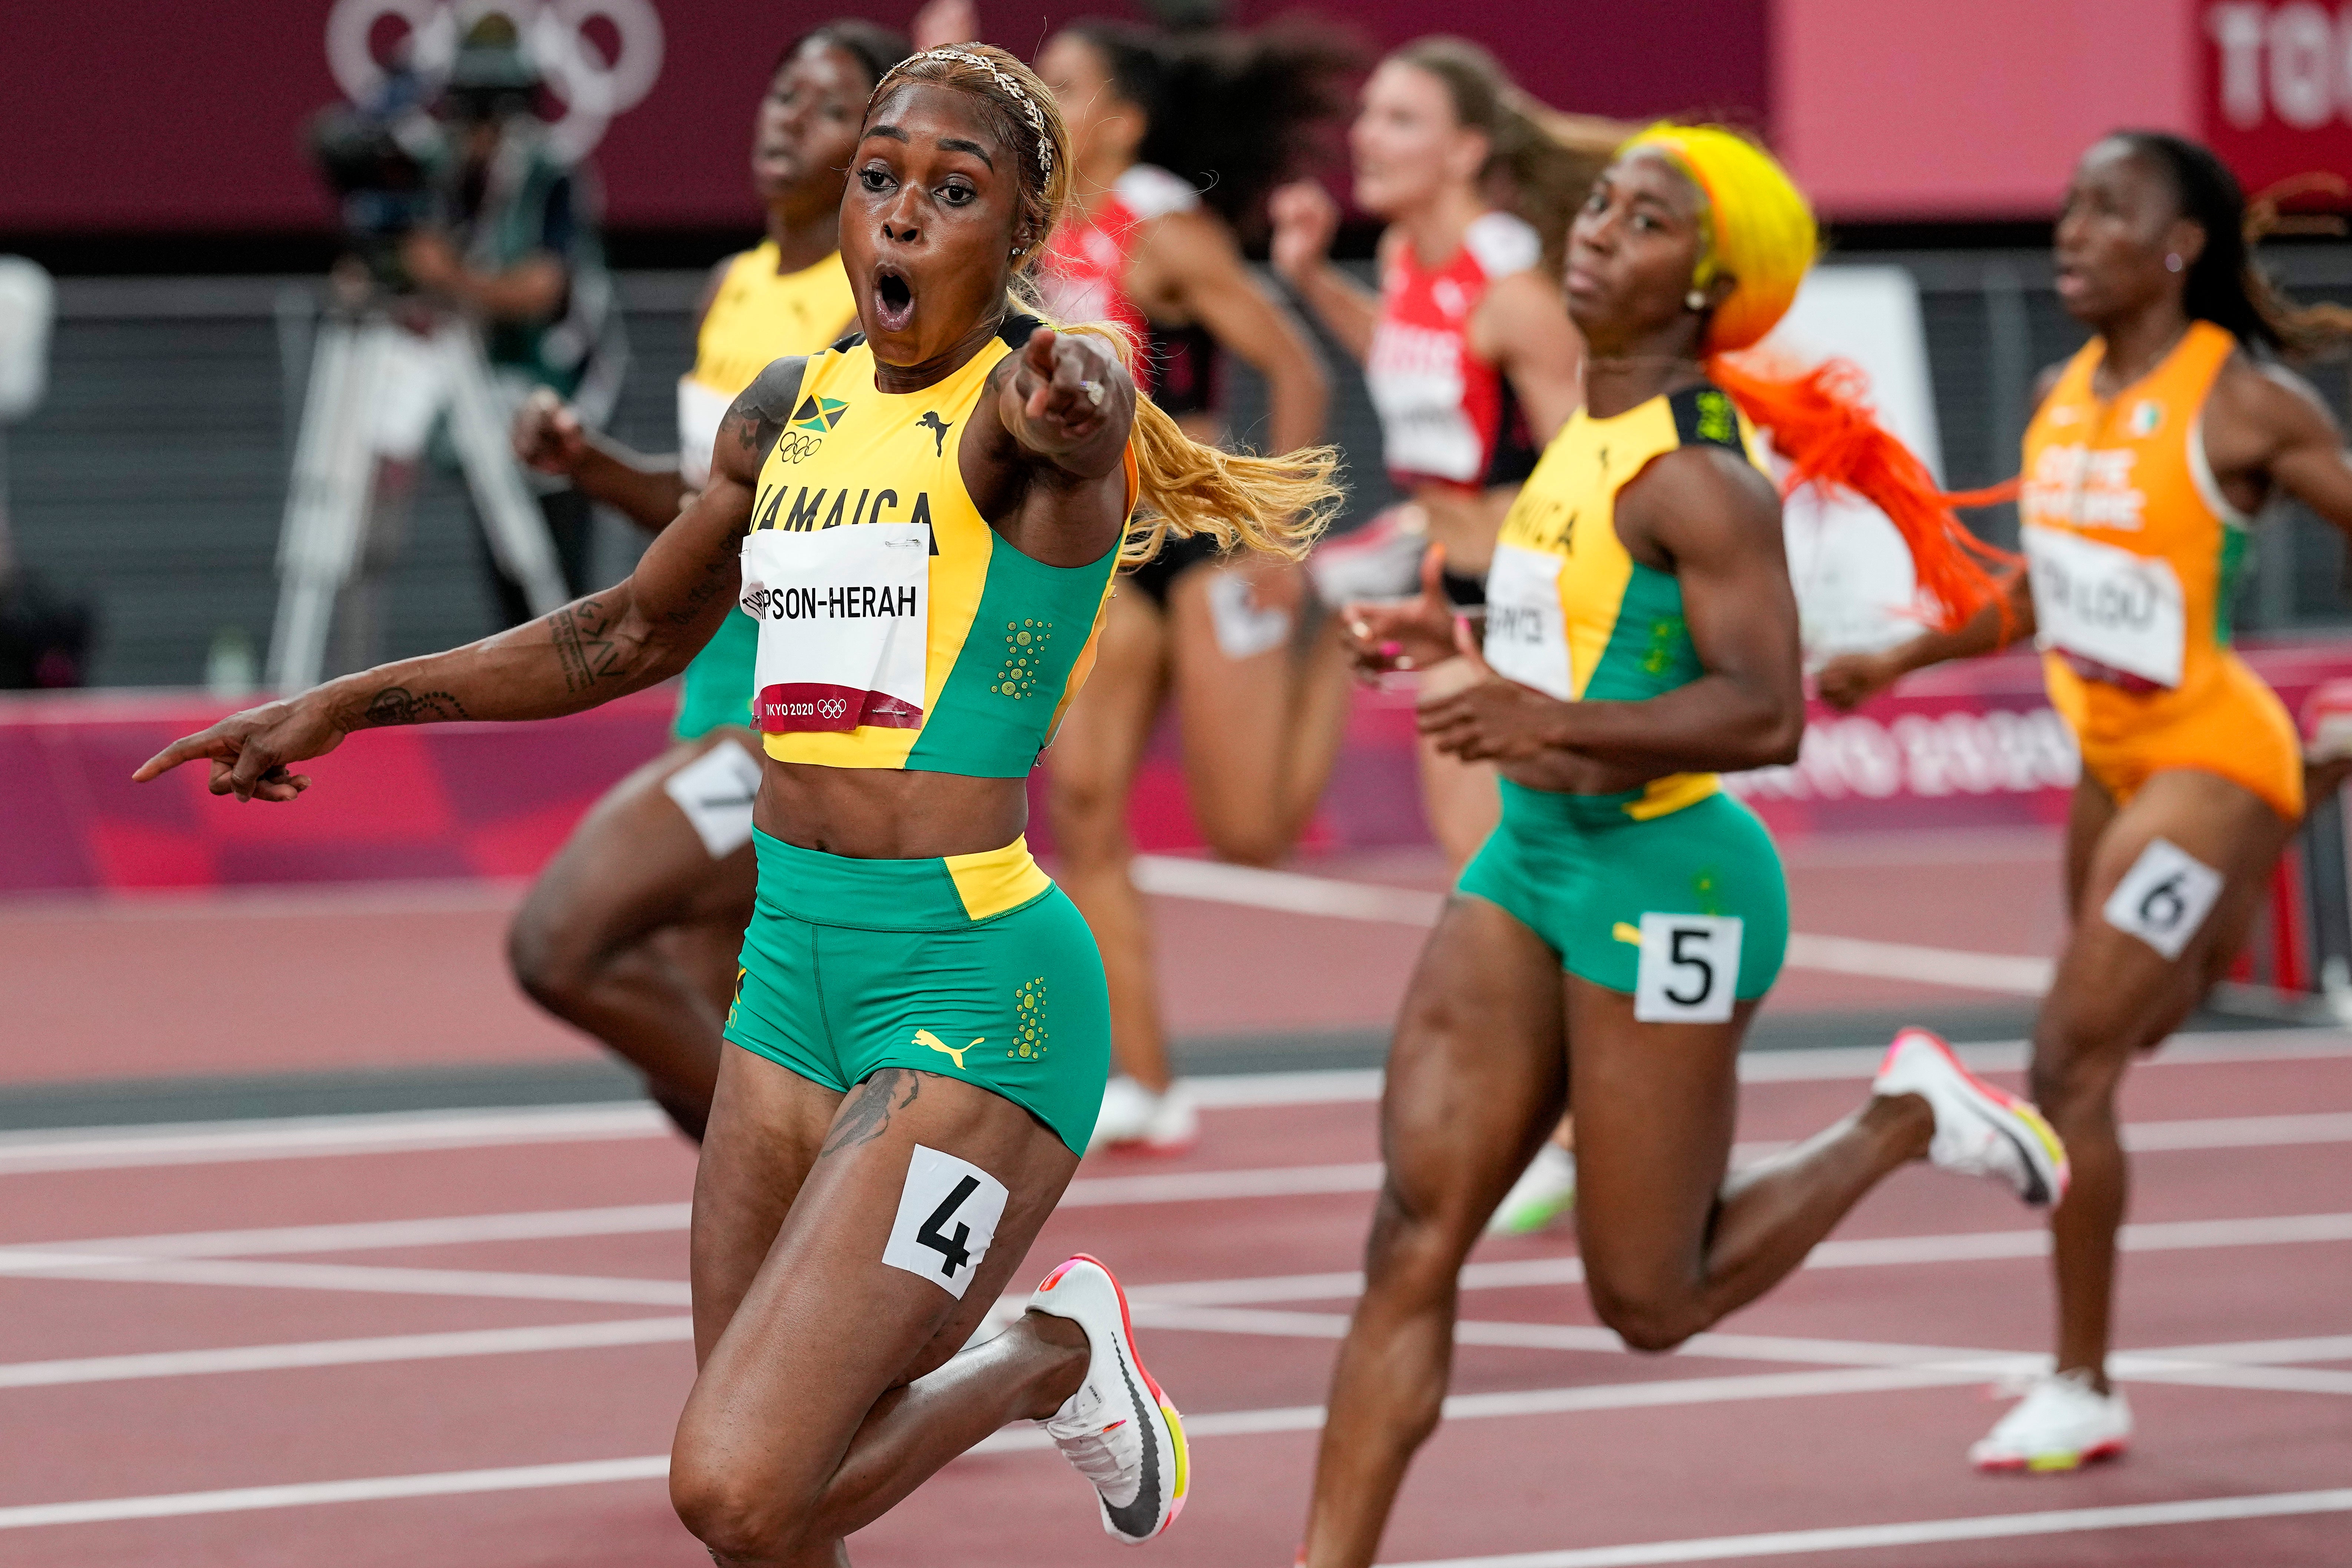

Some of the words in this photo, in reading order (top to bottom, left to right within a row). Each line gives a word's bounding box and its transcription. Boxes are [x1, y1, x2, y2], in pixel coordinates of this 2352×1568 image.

[765, 703, 788, 716] TOKYO
[790, 703, 814, 716] 2020
[2139, 872, 2185, 931] 6
[1665, 930, 1713, 1006] 5
[916, 1175, 981, 1279] 4
